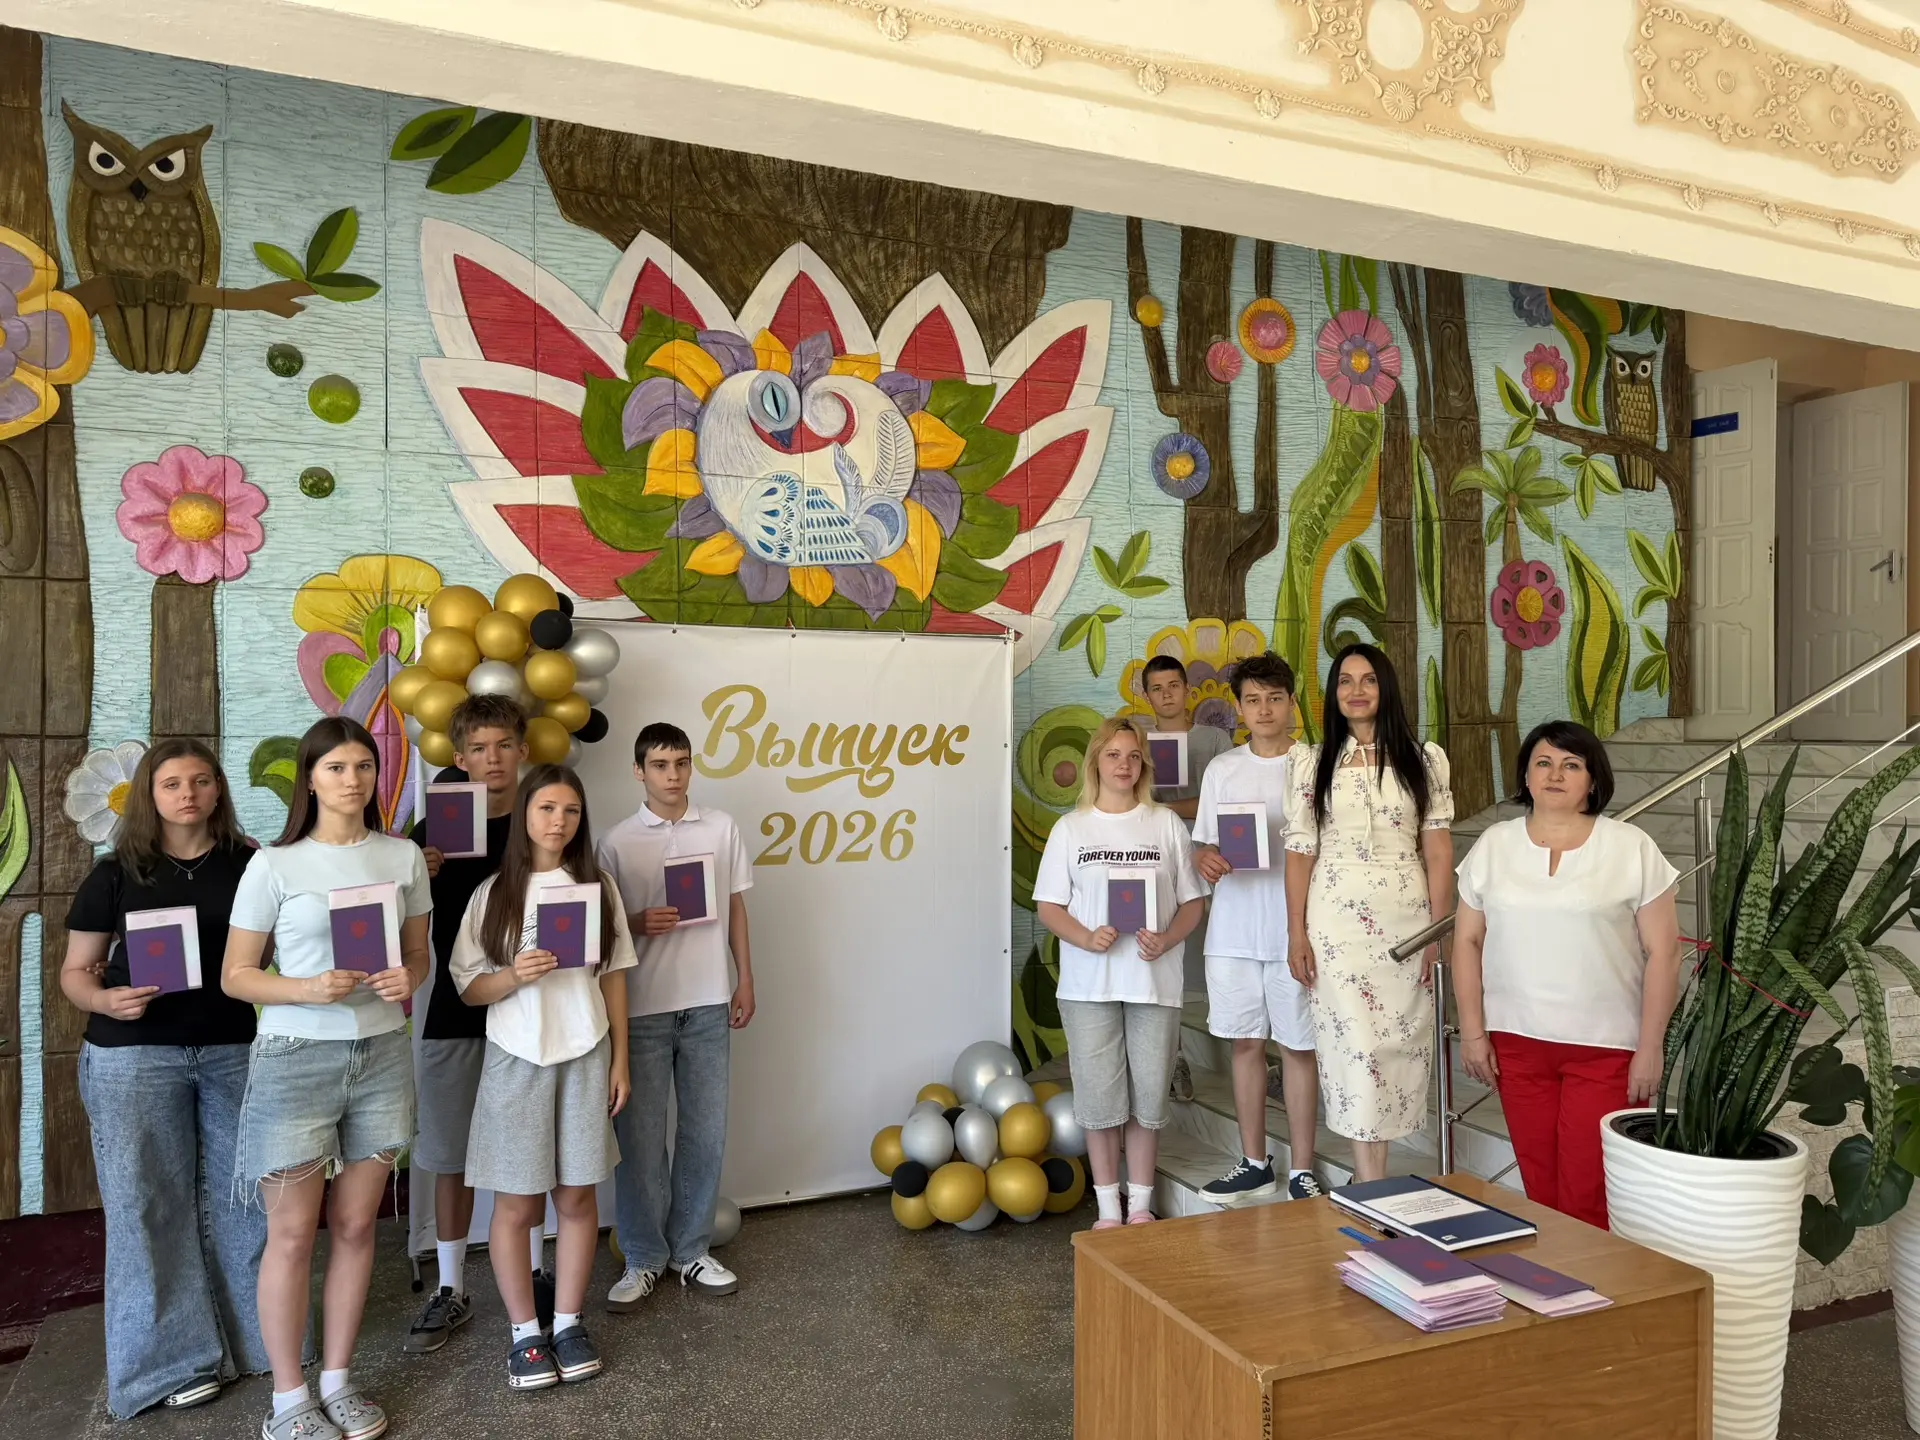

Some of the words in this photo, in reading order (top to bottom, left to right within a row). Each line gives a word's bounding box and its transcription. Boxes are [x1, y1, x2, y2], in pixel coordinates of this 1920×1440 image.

[693, 684, 970, 799] Выпуск
[752, 809, 917, 866] 2026
[1077, 851, 1123, 864] FOREVER
[1125, 851, 1160, 861] YOUNG
